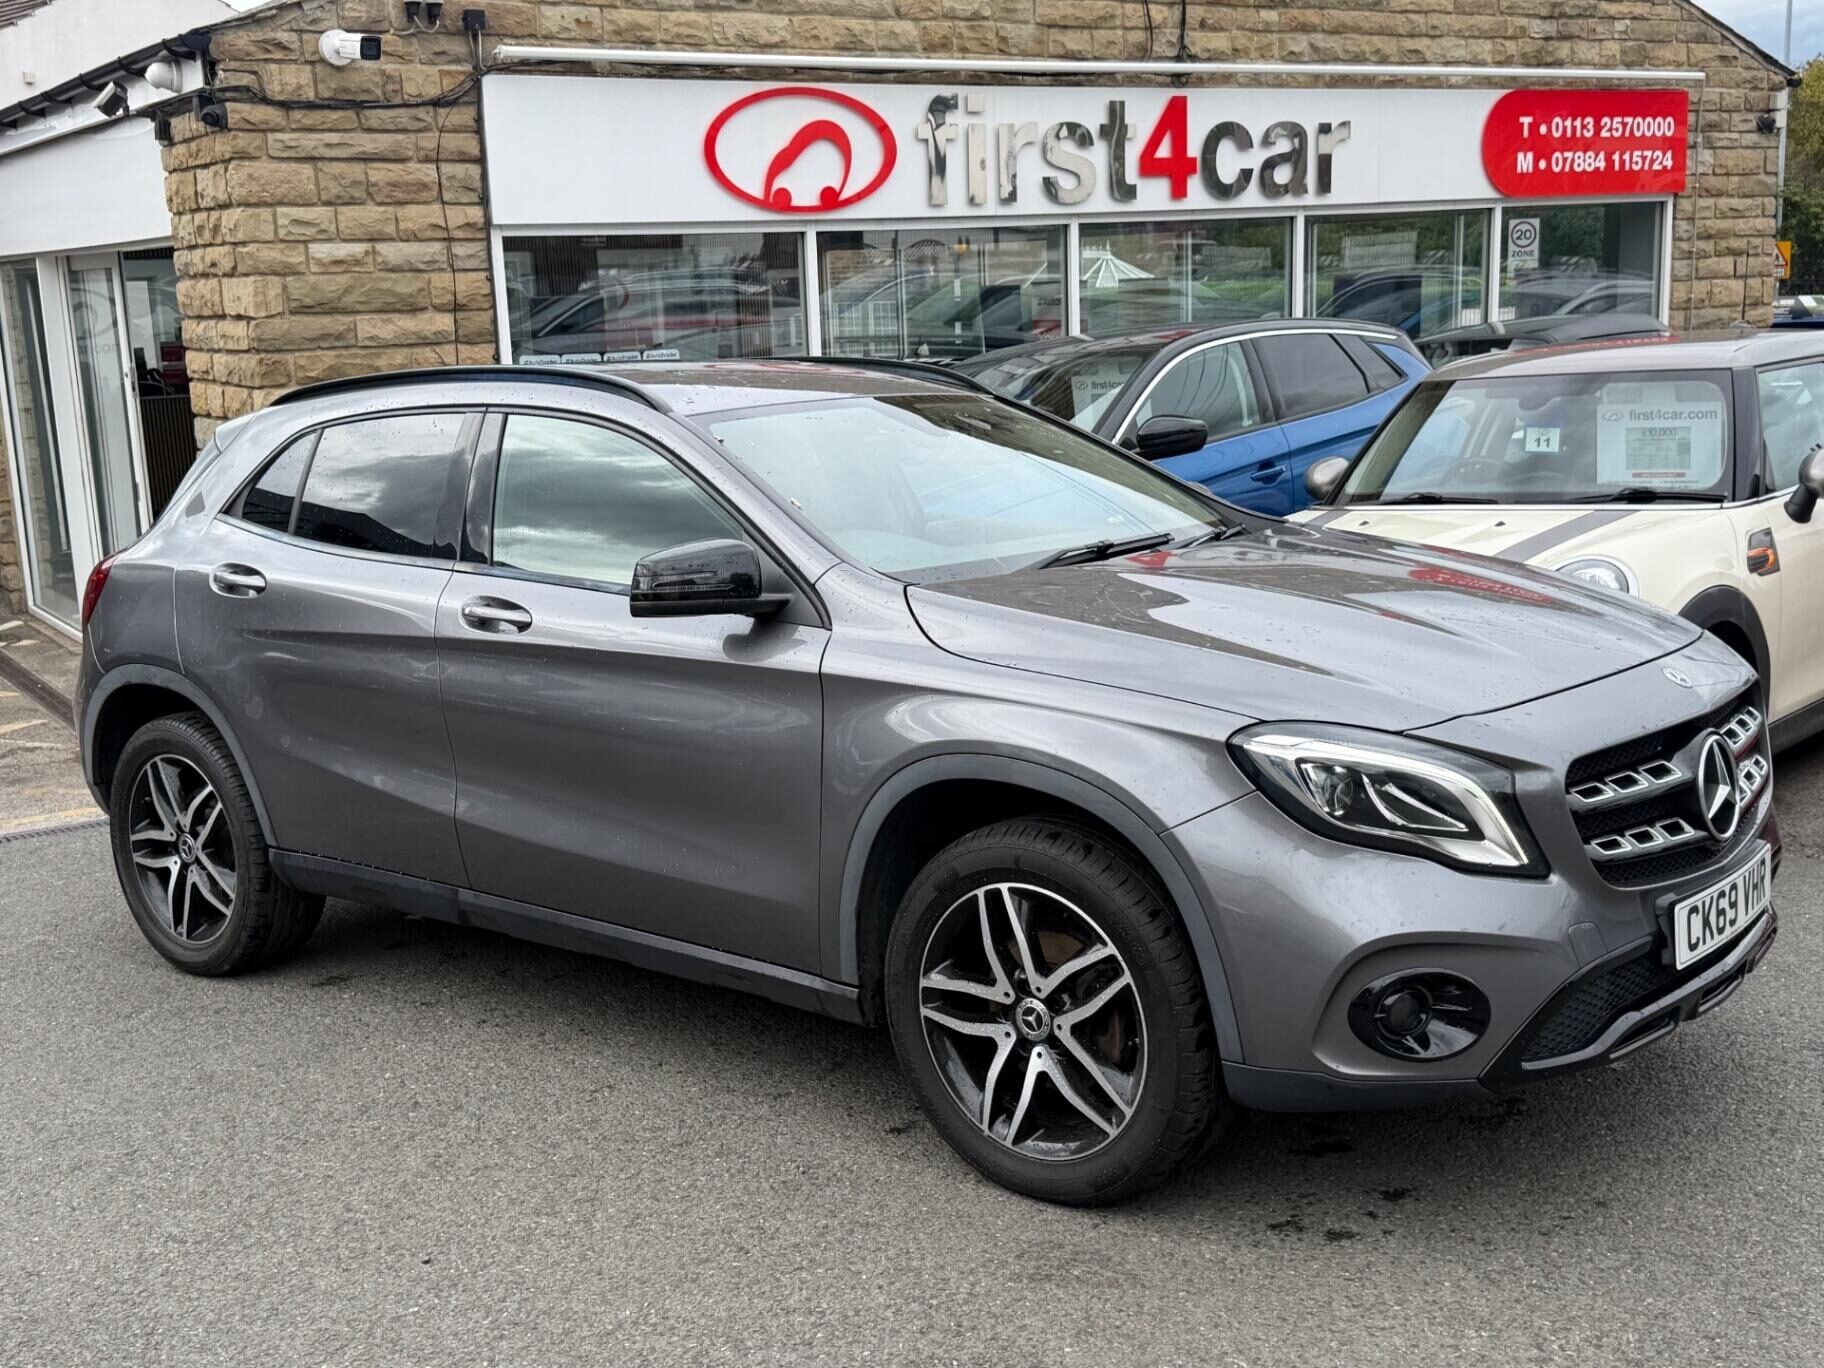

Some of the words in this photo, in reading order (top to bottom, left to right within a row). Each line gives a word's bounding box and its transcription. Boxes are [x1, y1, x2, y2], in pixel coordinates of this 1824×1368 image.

[1519, 116, 1533, 138] T
[1551, 116, 1594, 138] 0113
[1600, 116, 1675, 138] 2570000
[917, 93, 1351, 206] first4car
[1516, 151, 1534, 173] M
[1551, 150, 1606, 172] 07884
[1611, 150, 1673, 172] 115724
[1514, 228, 1533, 241] 20
[1511, 249, 1536, 258] ZONE
[1629, 409, 1718, 422] first4car.com
[1534, 437, 1551, 448] 11
[1686, 881, 1739, 953] CK69
[1742, 857, 1767, 917] VHR
